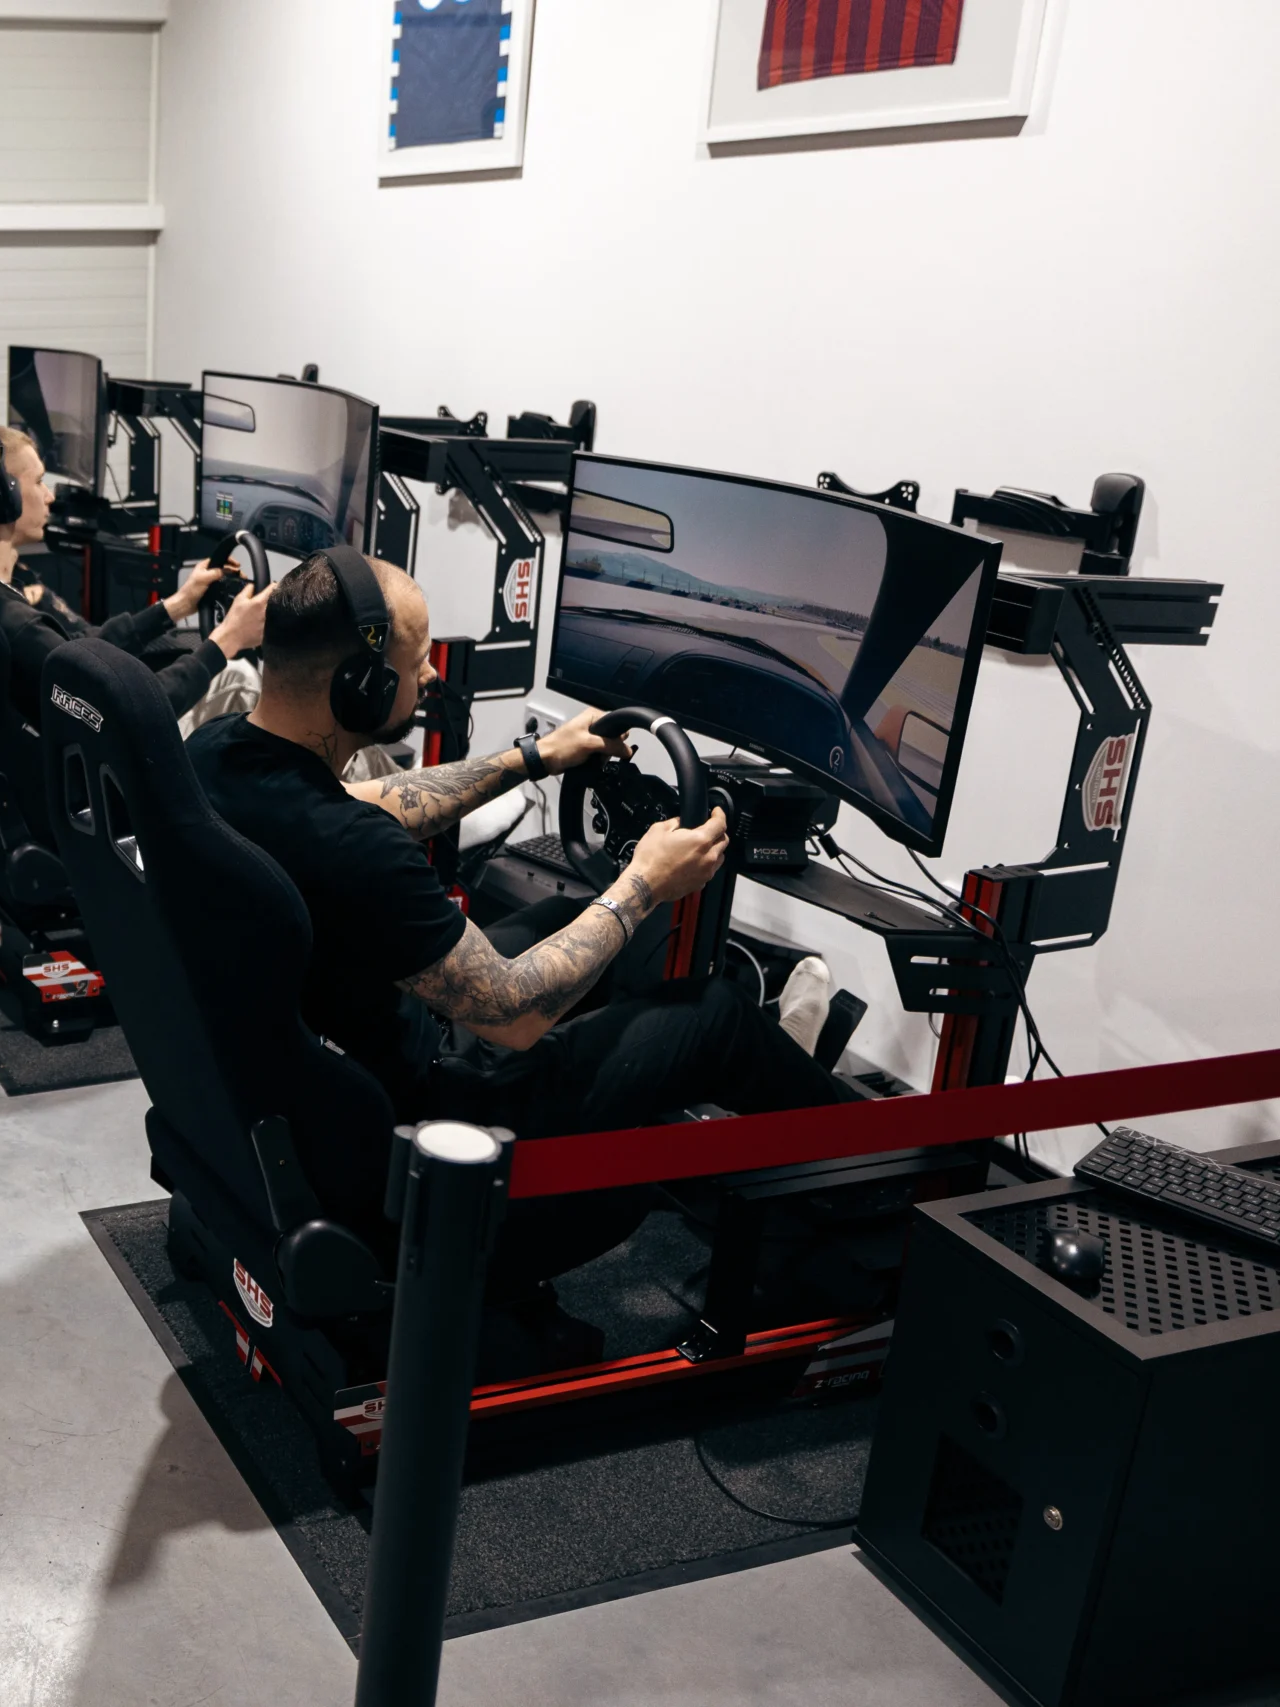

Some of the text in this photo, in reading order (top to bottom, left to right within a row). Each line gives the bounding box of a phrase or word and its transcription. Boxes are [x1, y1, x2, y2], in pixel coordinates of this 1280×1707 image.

[514, 561, 531, 619] SHS
[52, 686, 102, 731] RACES
[717, 774, 730, 784] MOZA
[1094, 738, 1126, 827] SHS
[753, 848, 788, 856] MOZA
[43, 963, 70, 973] SHS
[75, 980, 89, 998] 2
[235, 1260, 272, 1319] SHS
